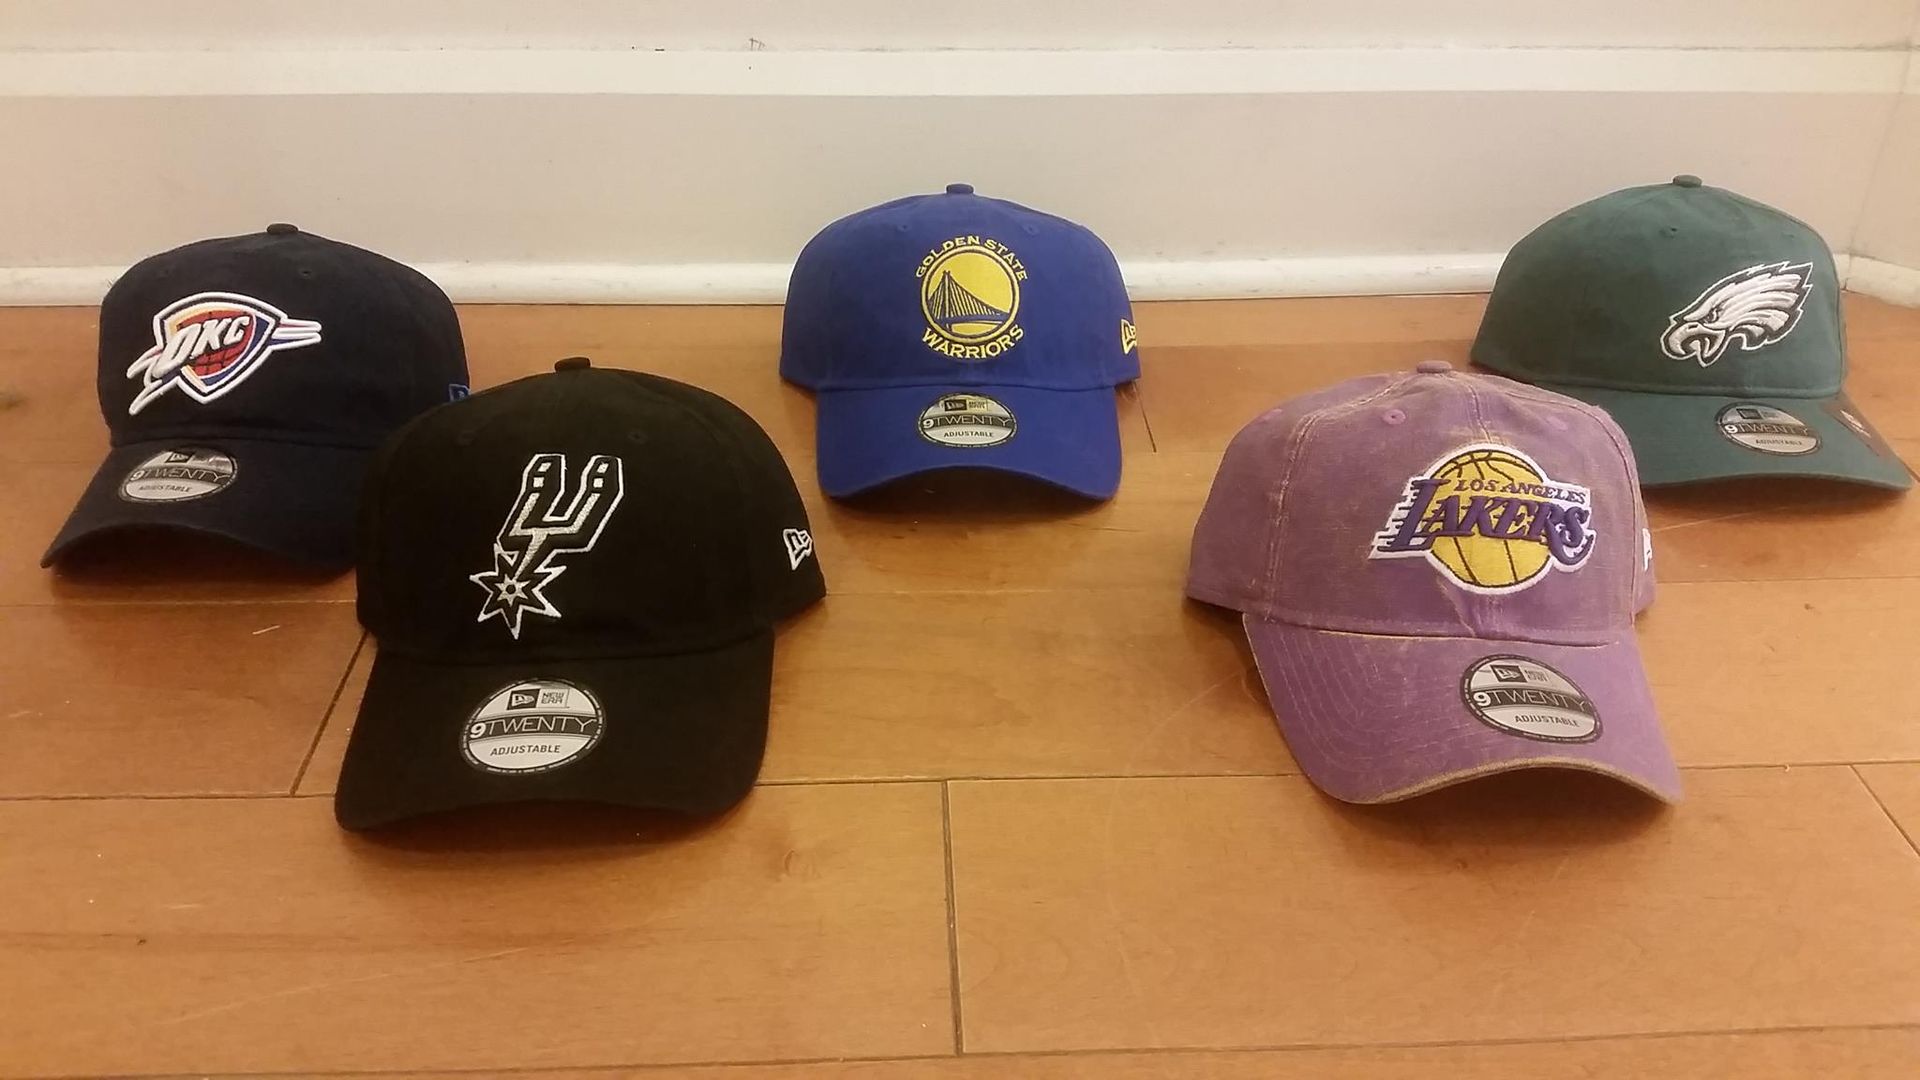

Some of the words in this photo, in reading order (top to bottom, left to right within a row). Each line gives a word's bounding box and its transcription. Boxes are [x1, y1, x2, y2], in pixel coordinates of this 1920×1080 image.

[916, 236, 980, 278] GOLDEN
[984, 239, 1028, 281] STATE
[151, 316, 250, 379] OKC
[922, 324, 1024, 359] WARRIORS
[923, 415, 1011, 429] 9TWENTY
[1724, 423, 1808, 435] 9TWENTY
[944, 430, 993, 438] ADJUSTABLE
[130, 467, 231, 482] 9TWENTY
[1454, 479, 1500, 492] LOS
[1500, 482, 1587, 504] ANGELES
[1377, 479, 1595, 565] LAKERS
[1473, 690, 1585, 711] 9TWENTY
[470, 716, 597, 738] 9TWENTY
[1514, 715, 1580, 728] ADJUSTABLE
[490, 745, 561, 756] ADJUSTABLE
